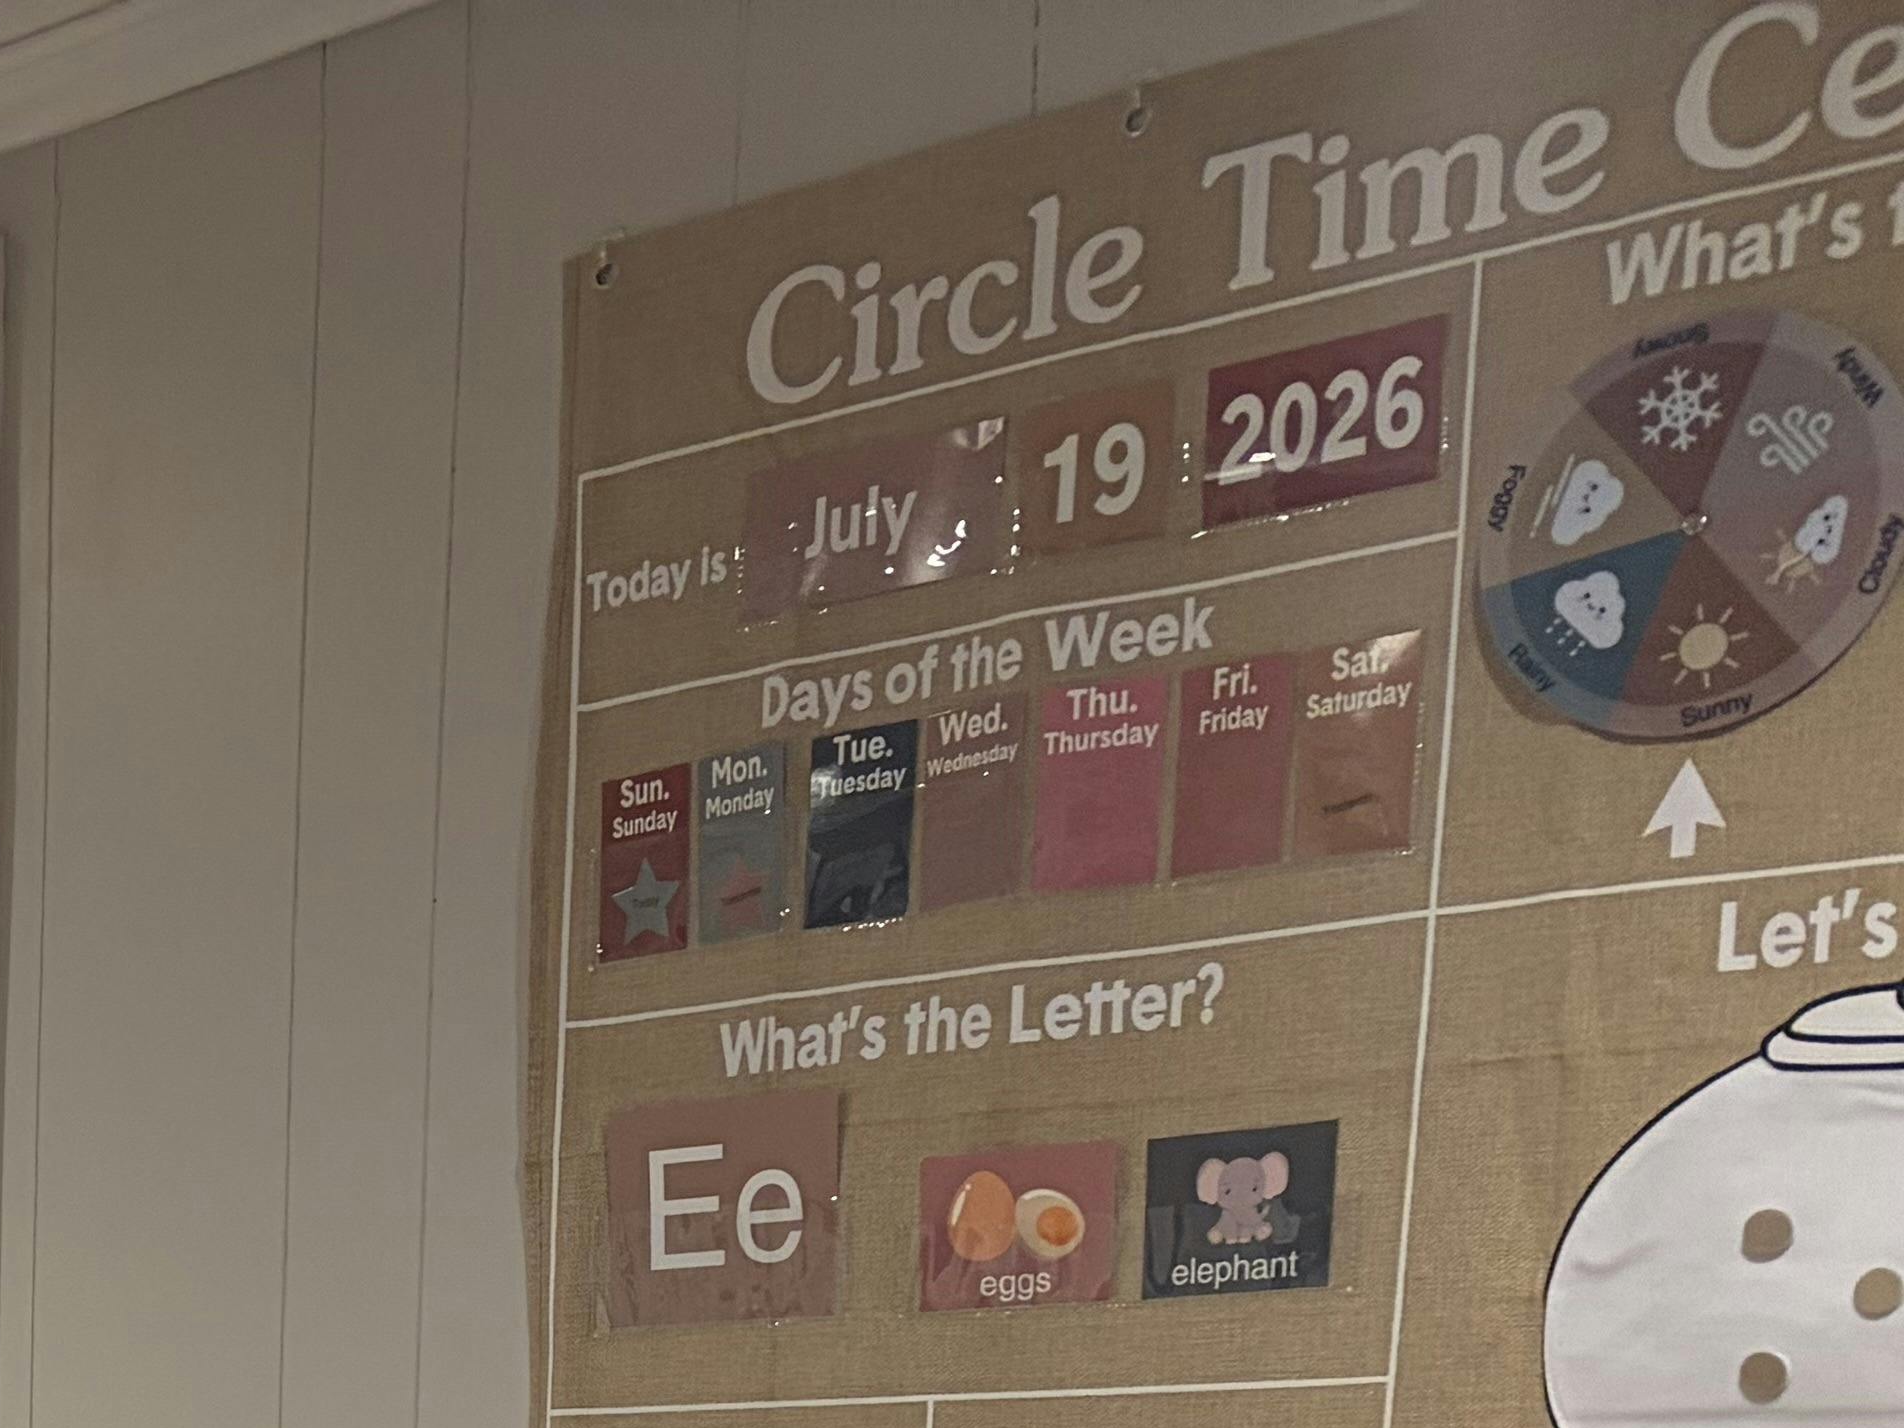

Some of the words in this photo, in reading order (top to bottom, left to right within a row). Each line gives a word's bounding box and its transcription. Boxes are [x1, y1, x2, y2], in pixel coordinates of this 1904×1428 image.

[747, 194, 1144, 403] Circle
[1202, 107, 1609, 290] Time
[1606, 192, 1864, 304] What's
[1631, 322, 1710, 360] Snowy
[1834, 345, 1886, 408] Windy
[1218, 354, 1424, 485] 2026
[1043, 421, 1145, 524] 19
[1487, 463, 1527, 532] Foggy
[805, 484, 917, 559] July
[586, 555, 692, 611] Today
[700, 545, 727, 585] is
[760, 671, 874, 729] Days
[885, 642, 939, 704] of
[951, 633, 1023, 692] the
[1043, 600, 1215, 673] Week
[1212, 664, 1258, 700] Fri.
[1330, 645, 1392, 679] Sat.
[1507, 641, 1556, 694] Rainy
[1066, 687, 1138, 719] Thu.
[1198, 701, 1269, 736] Friday
[1305, 680, 1413, 721] Saturday
[1680, 690, 1755, 728] Sunny
[939, 703, 1008, 746] Wed.
[1043, 720, 1160, 760] Thursday
[833, 734, 893, 765] Tue.
[927, 742, 1018, 778] Wednesday
[711, 754, 768, 788] Mon.
[819, 767, 907, 800] Tuesday
[620, 778, 669, 808] Sun.
[705, 787, 774, 819] Monday
[612, 810, 678, 839] Sunday
[1716, 888, 1899, 973] Let's
[721, 996, 887, 1078] What's
[902, 994, 989, 1058] the
[1008, 963, 1226, 1046] Letter?
[647, 1143, 805, 1271] Ee
[979, 1266, 1053, 1302] eggs
[1171, 1251, 1299, 1290] elephant
